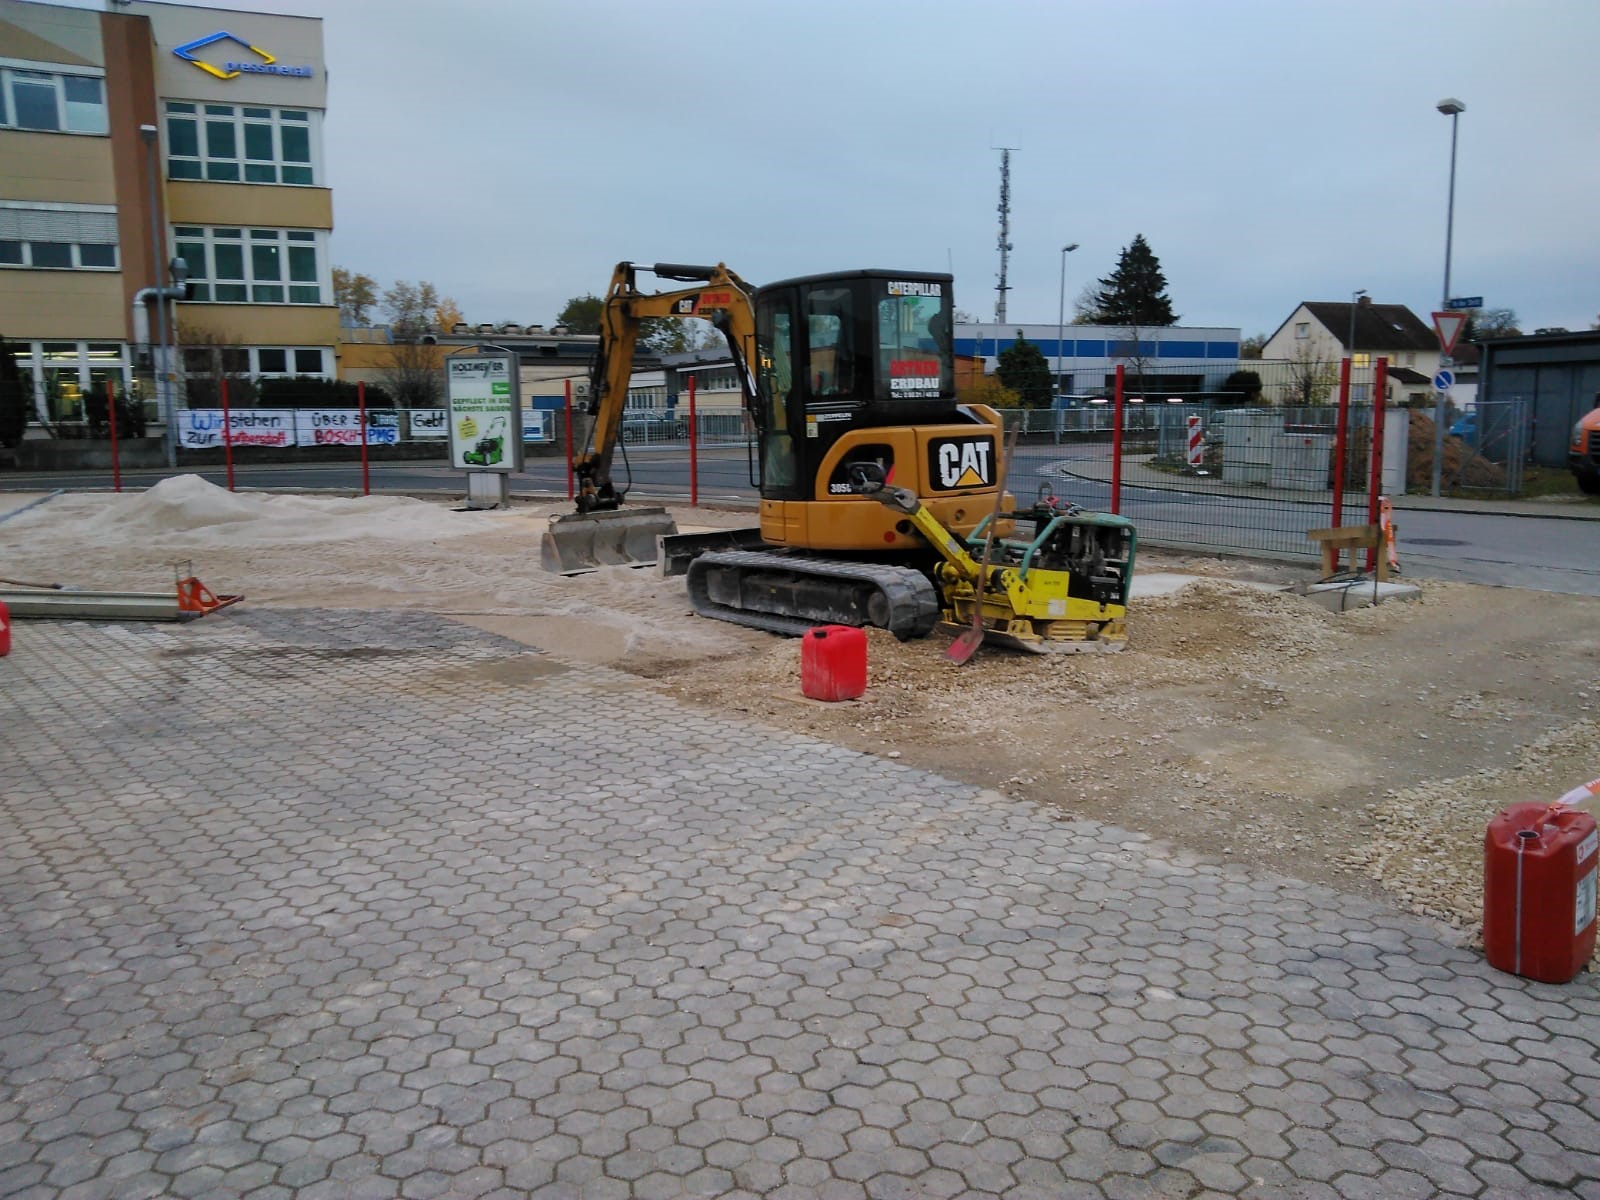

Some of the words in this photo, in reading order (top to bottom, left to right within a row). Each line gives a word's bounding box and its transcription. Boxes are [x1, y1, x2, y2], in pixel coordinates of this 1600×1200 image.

[888, 281, 942, 297] CATERPILLAR
[890, 378, 940, 390] ERDBAU
[312, 412, 348, 427] ÜBER
[187, 431, 217, 444] zur
[938, 442, 990, 487] CAT
